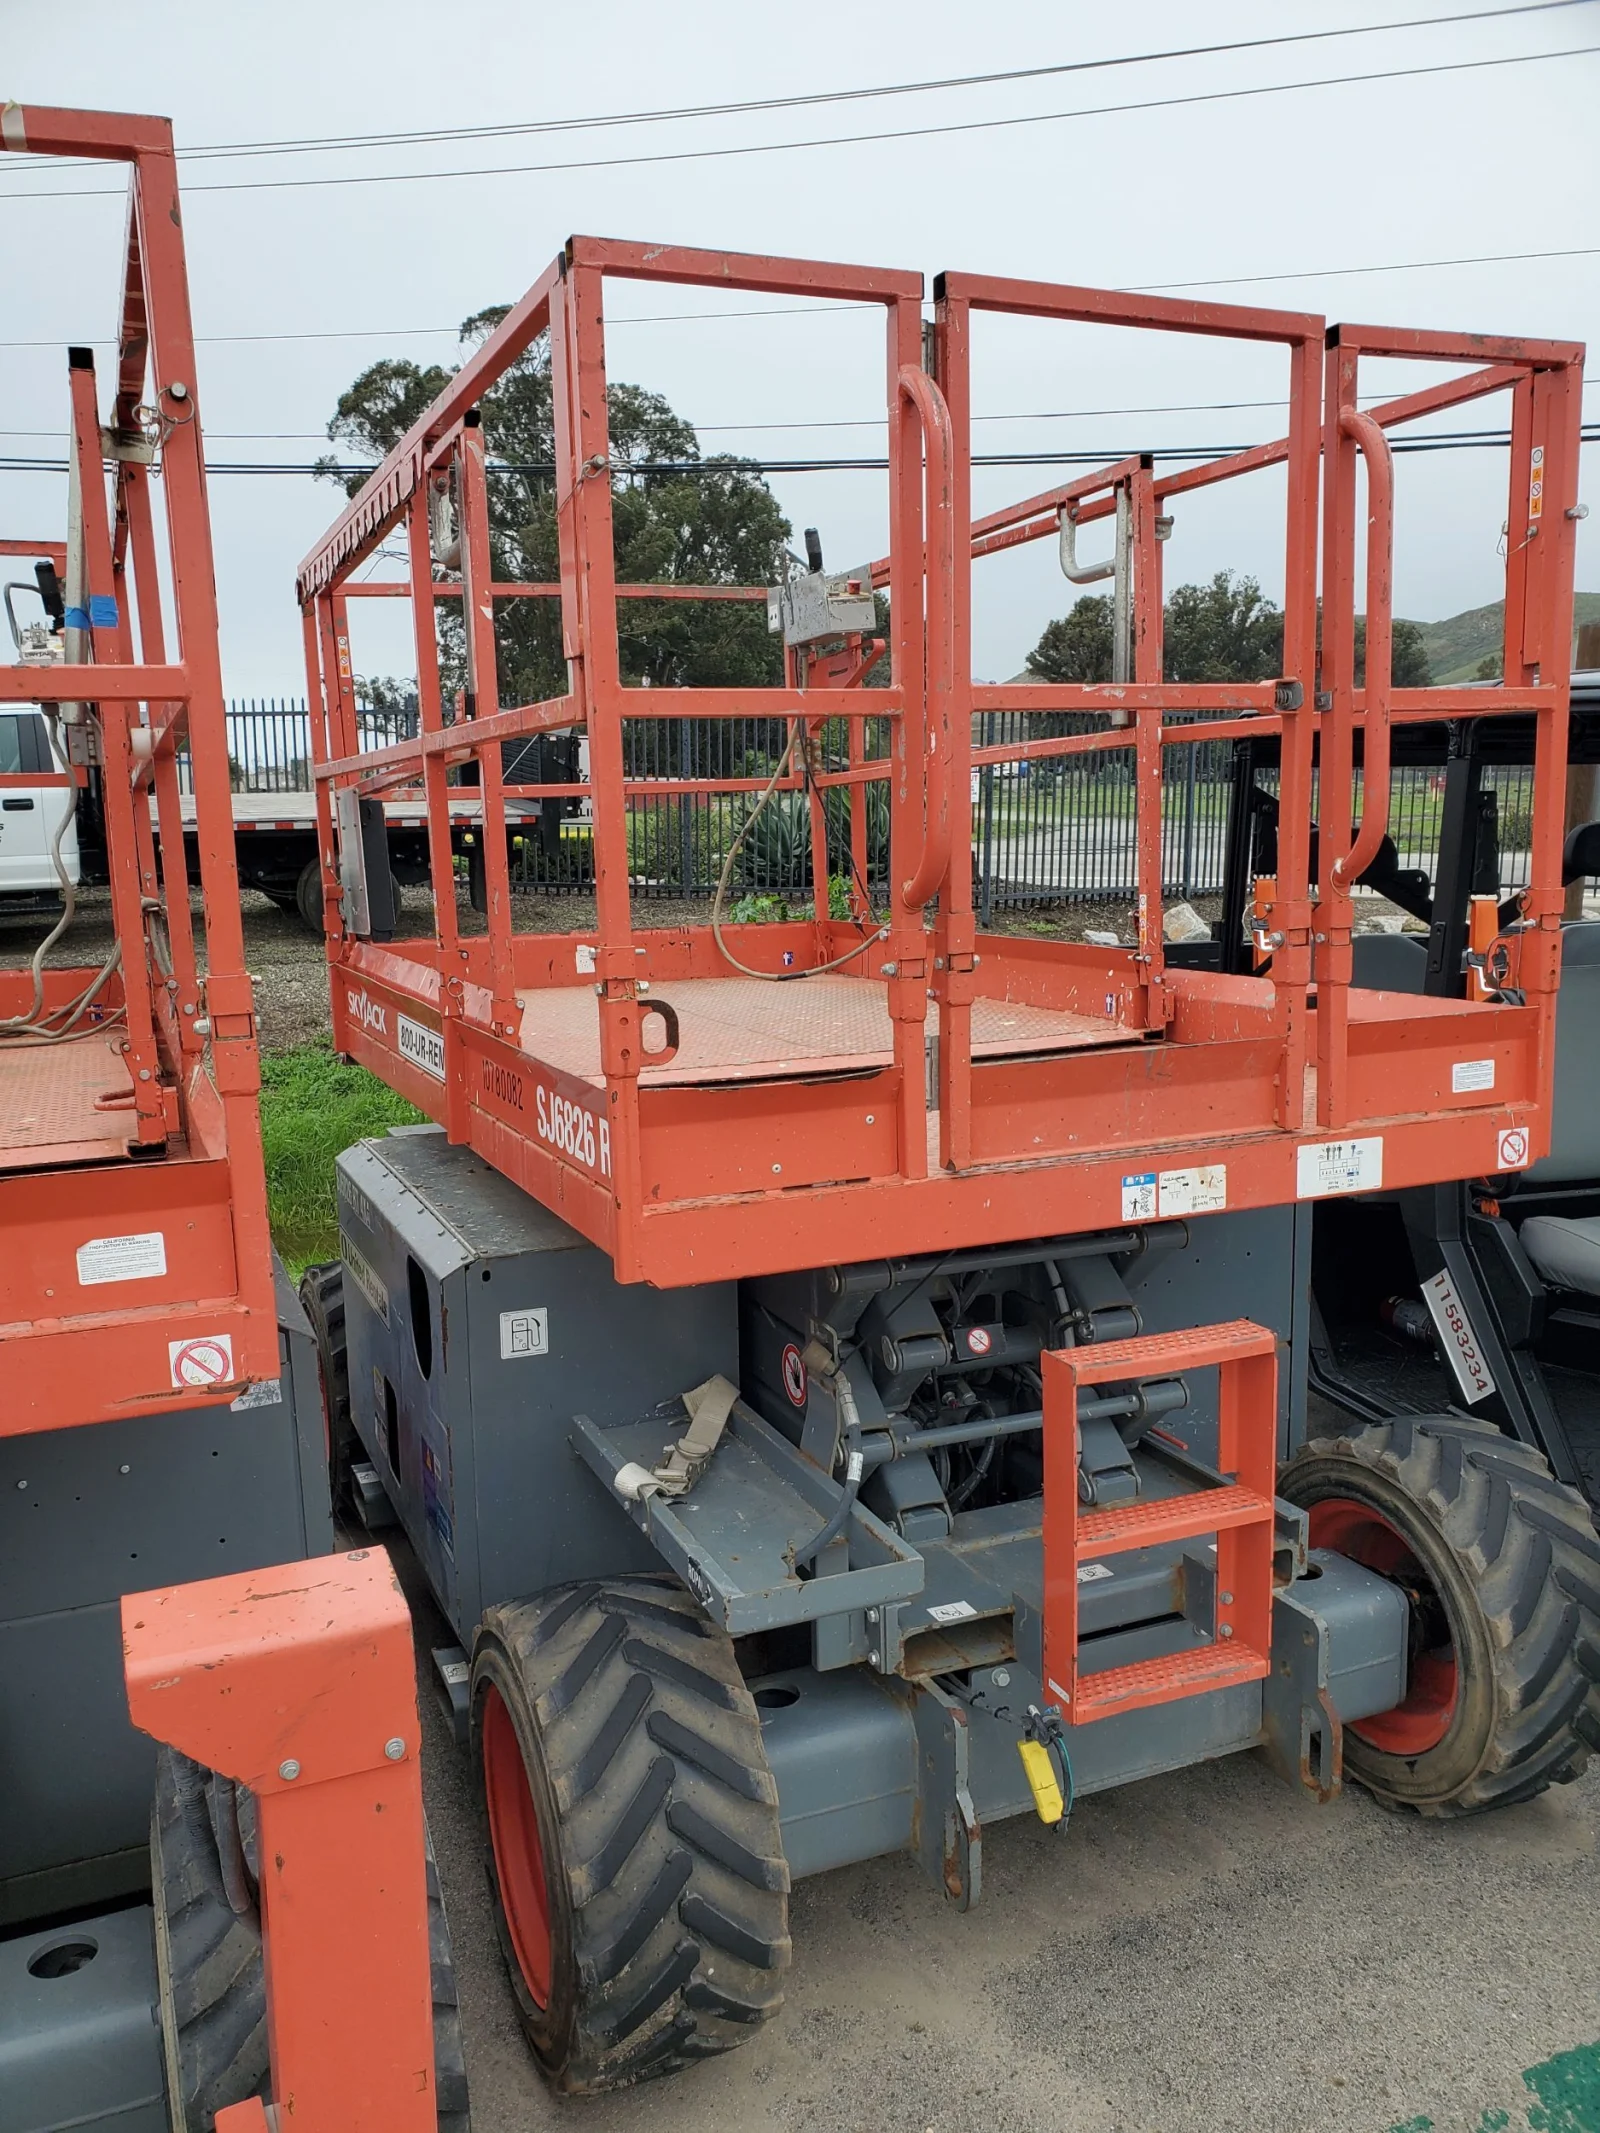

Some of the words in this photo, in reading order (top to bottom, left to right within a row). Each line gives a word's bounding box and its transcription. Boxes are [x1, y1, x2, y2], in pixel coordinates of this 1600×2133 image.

[347, 986, 388, 1036] SKYJACK
[482, 1059, 524, 1111] 10780082
[536, 1084, 596, 1168] SJ6826
[102, 1236, 136, 1245] CALIFORNIA
